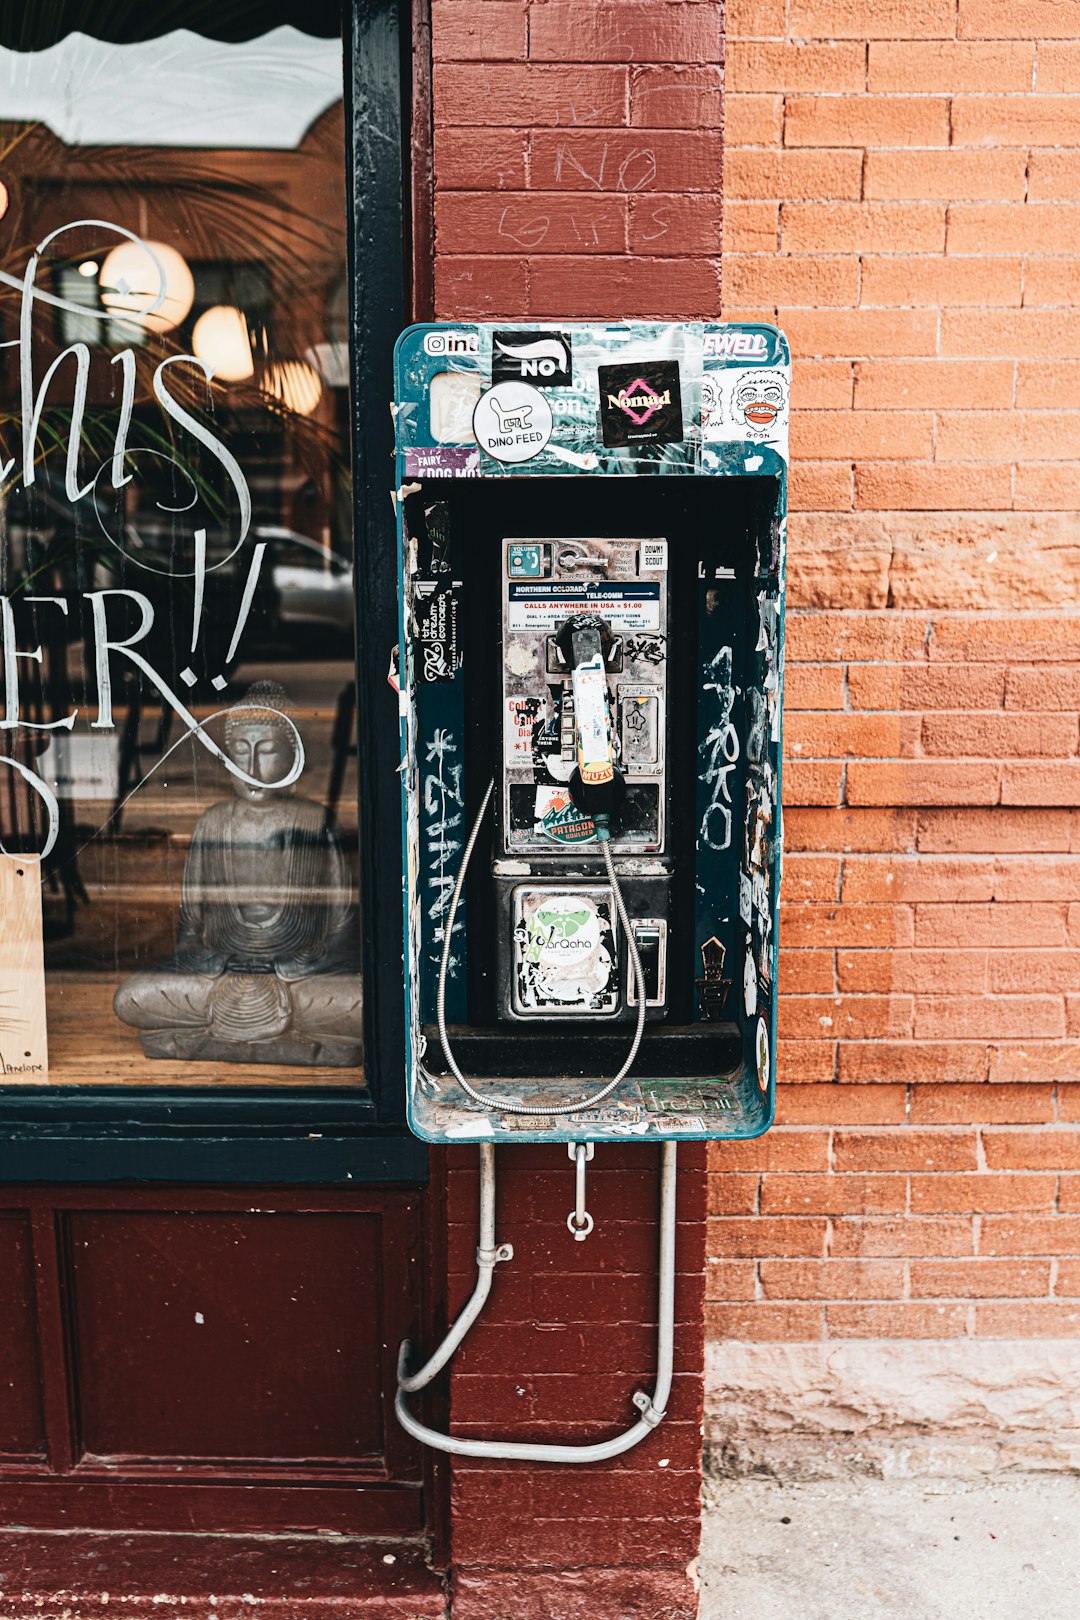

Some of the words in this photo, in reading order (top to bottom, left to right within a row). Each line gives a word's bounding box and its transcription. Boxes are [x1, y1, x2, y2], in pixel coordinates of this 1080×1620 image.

[555, 142, 656, 192] NO
[521, 359, 556, 376] NO
[607, 389, 671, 410] Nomad
[488, 436, 514, 448] DINO
[515, 431, 543, 444] FEED
[746, 431, 770, 439] GOON
[418, 456, 441, 467] FAIRY
[645, 557, 663, 566] SCOUT
[430, 603, 438, 639] dream
[437, 594, 447, 639] concept
[421, 619, 430, 638] the
[551, 821, 595, 836] PATAGON
[566, 830, 593, 839] BOULDER
